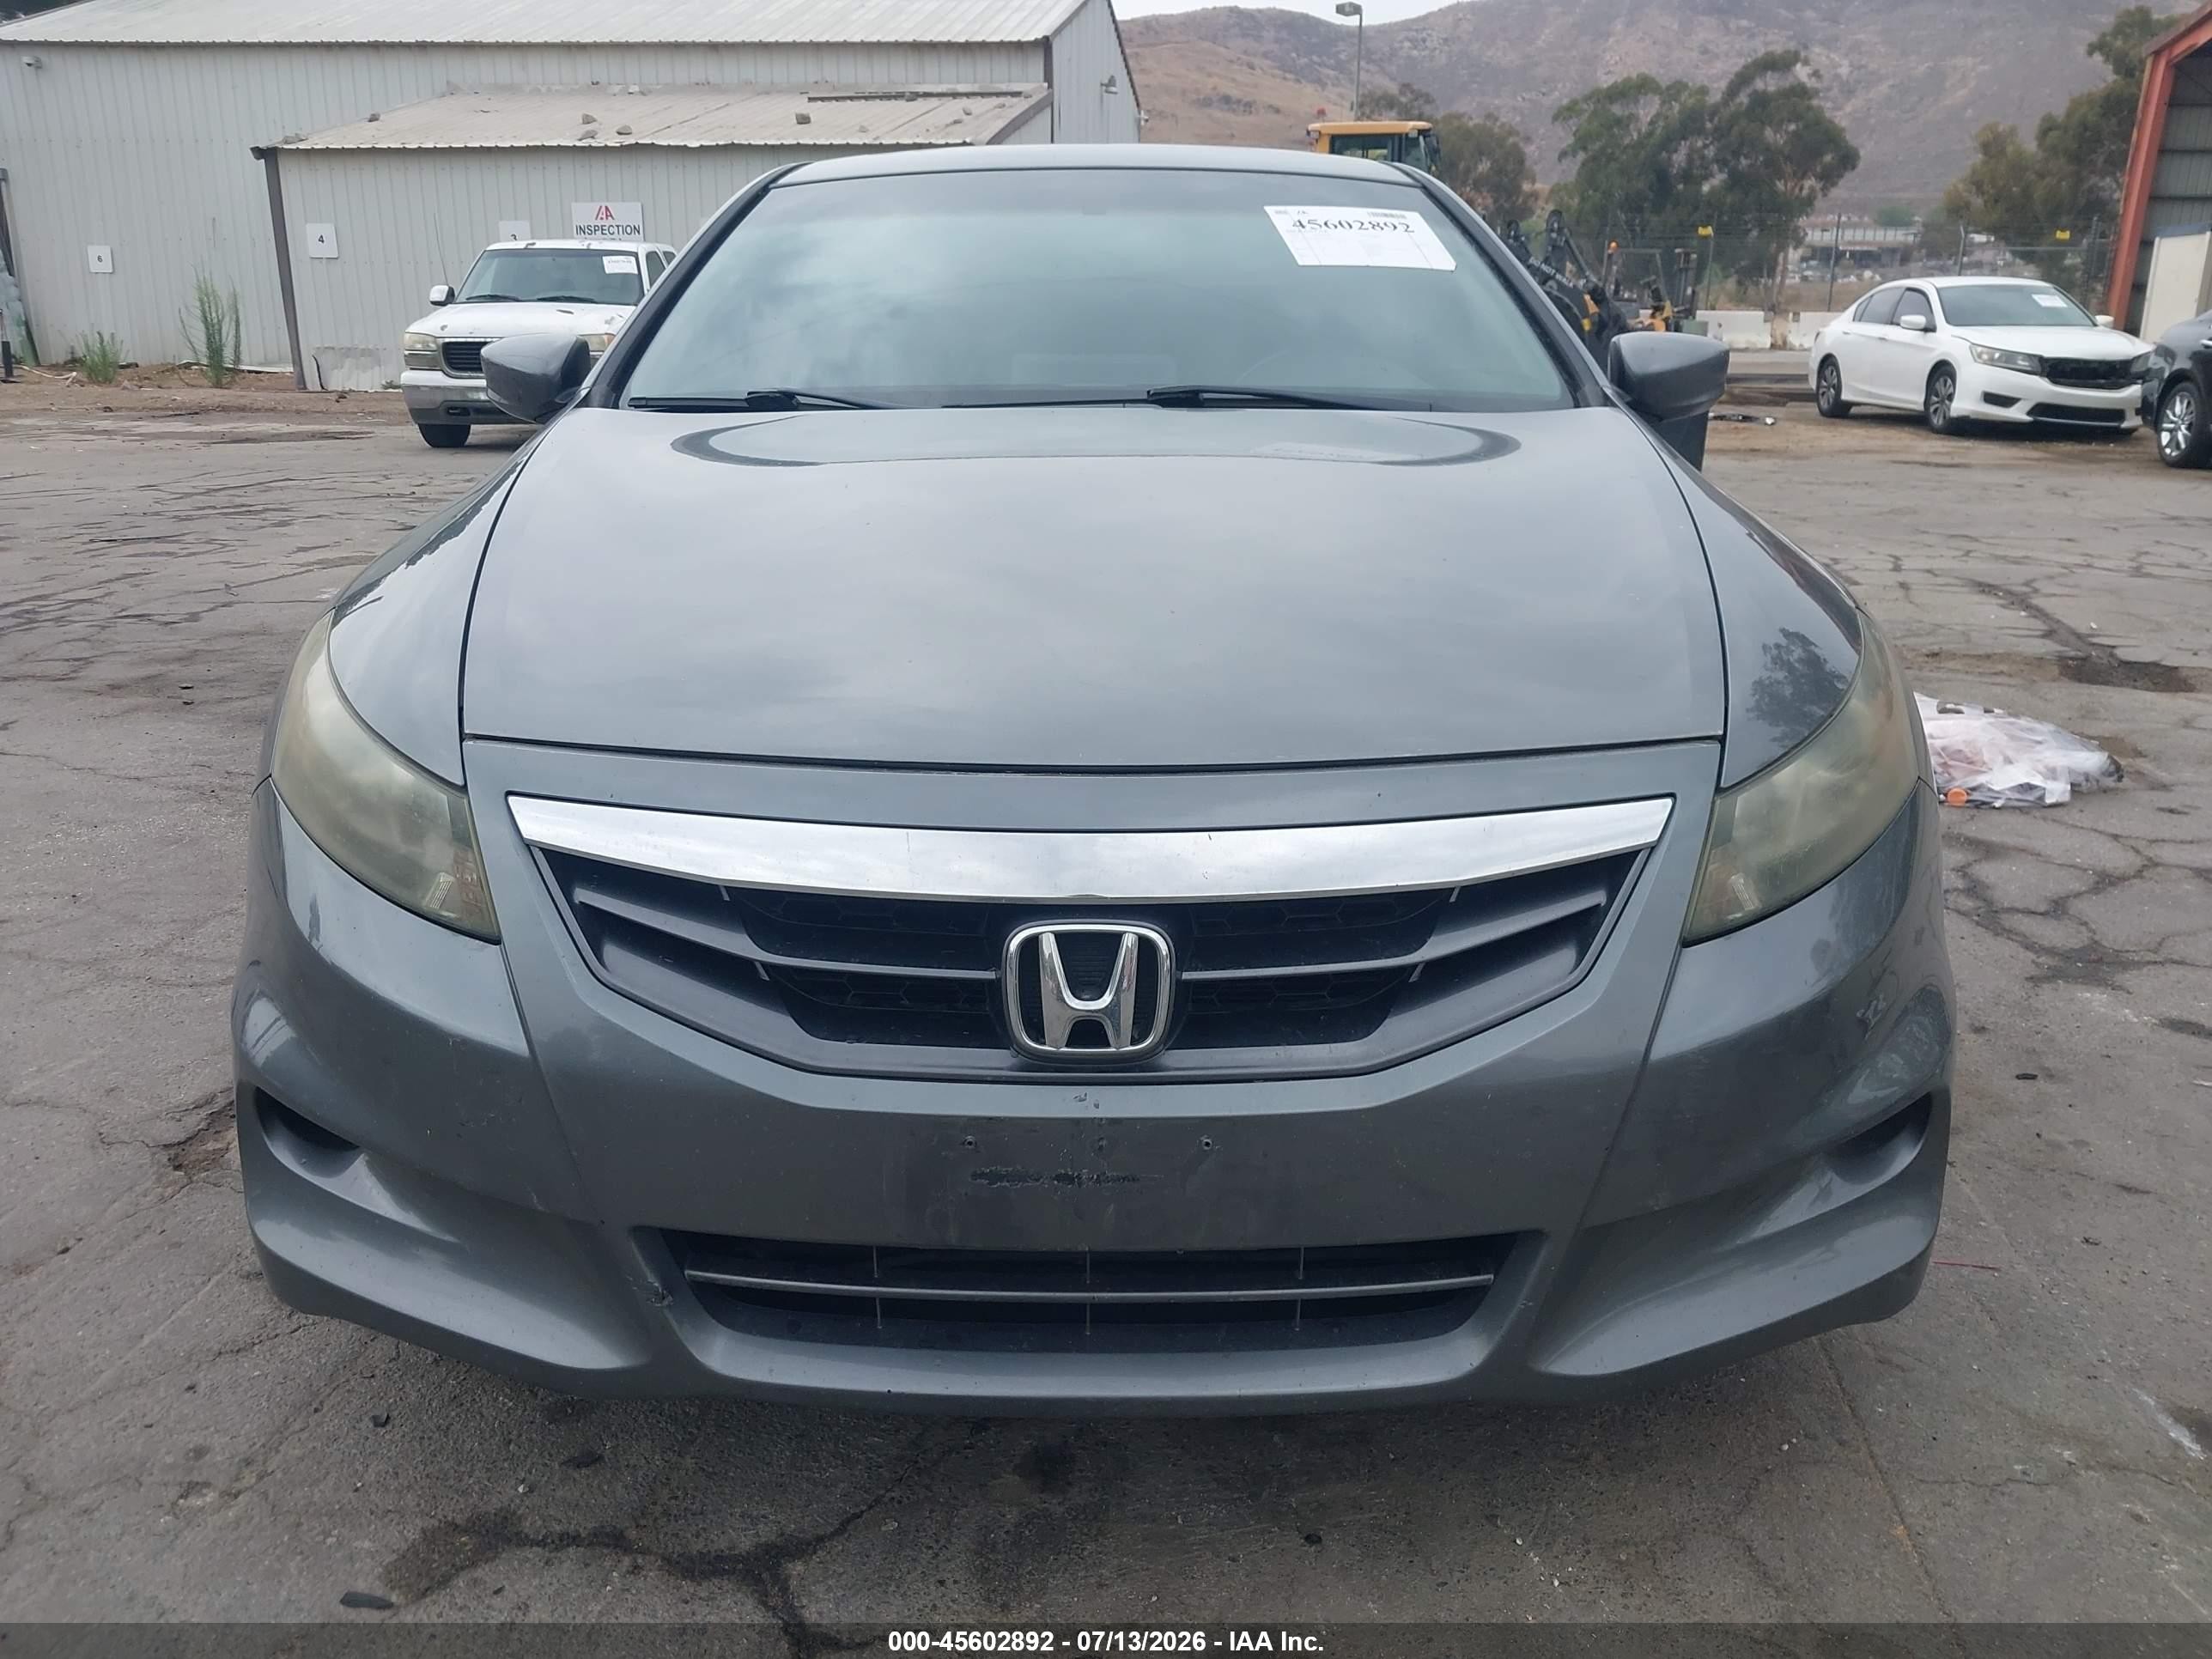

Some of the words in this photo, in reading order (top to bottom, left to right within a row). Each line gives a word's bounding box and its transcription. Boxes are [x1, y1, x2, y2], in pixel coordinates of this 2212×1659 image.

[575, 224, 641, 236] INSPECTION
[1291, 218, 1415, 234] 45602892
[318, 234, 325, 244] 4
[97, 254, 103, 263] 6
